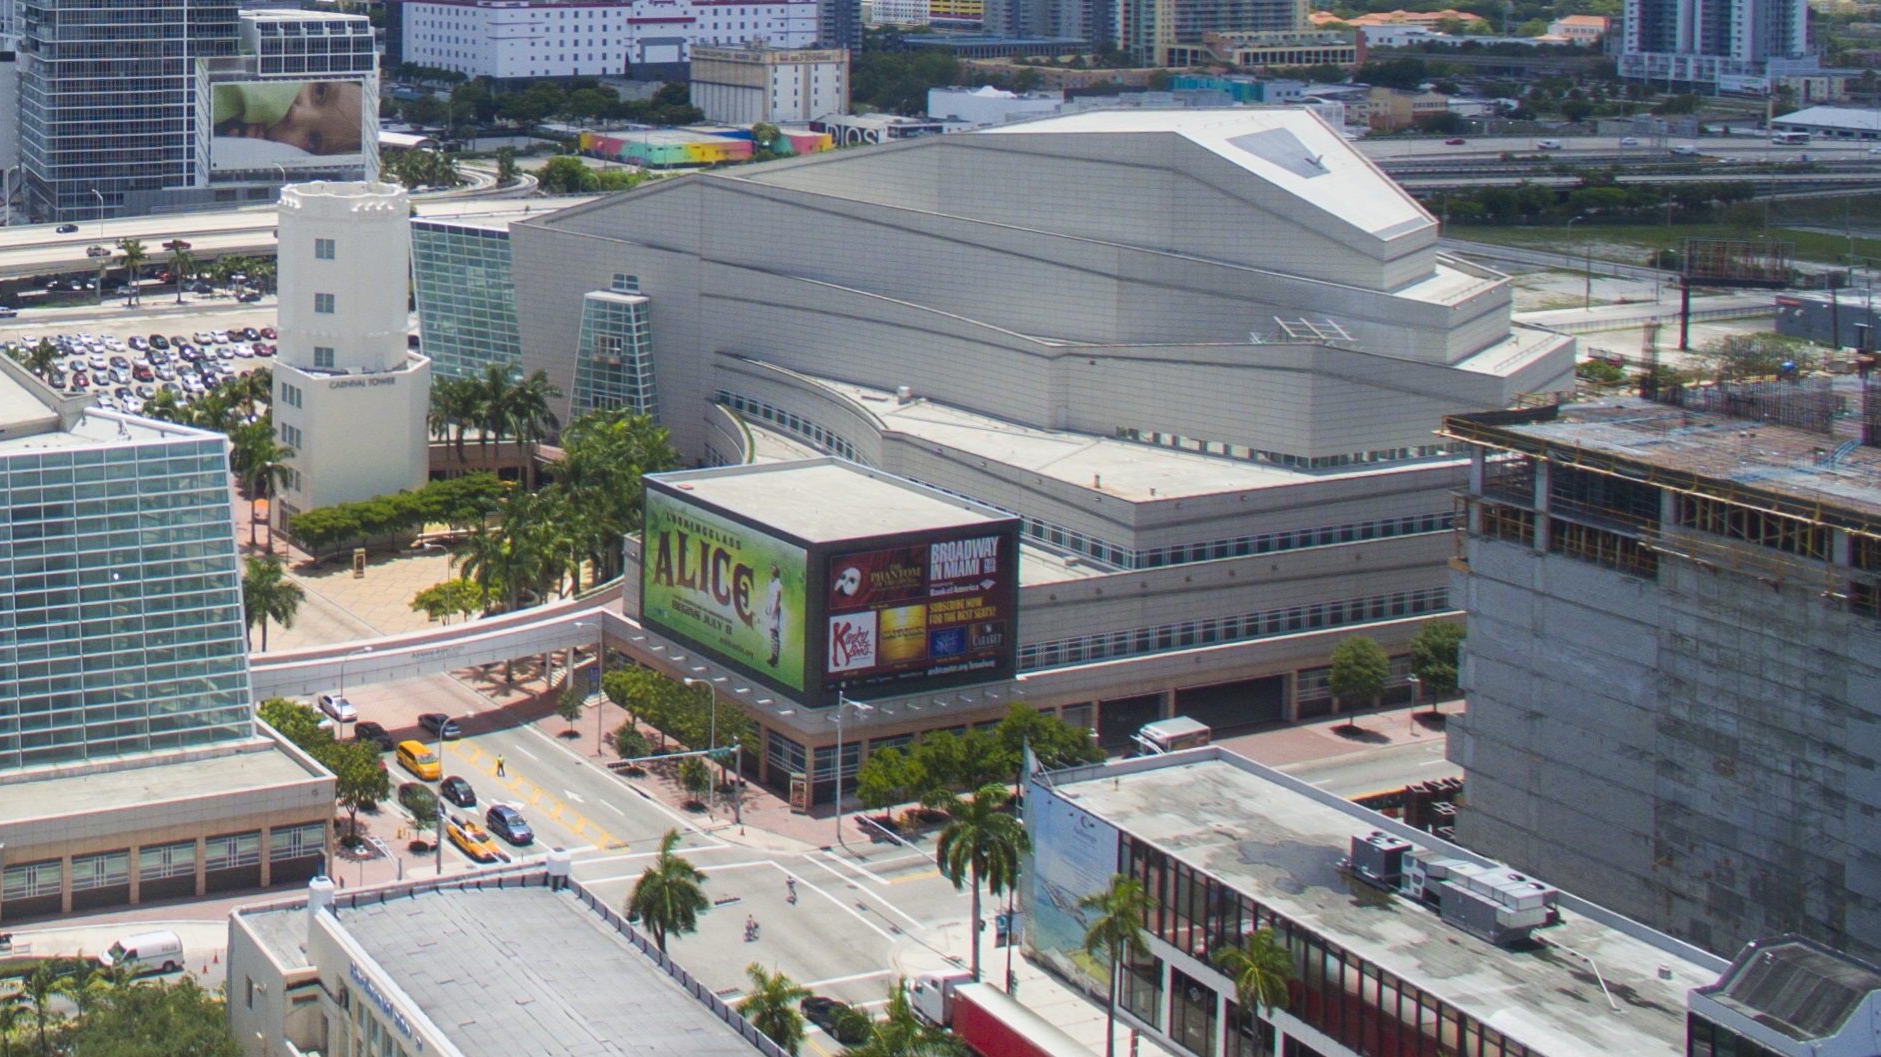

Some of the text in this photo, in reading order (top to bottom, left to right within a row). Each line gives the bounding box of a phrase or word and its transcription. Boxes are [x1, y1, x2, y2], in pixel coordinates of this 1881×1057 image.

[329, 376, 396, 390] CARNIVAL TOWER
[930, 535, 1000, 564] BROADWAY
[653, 529, 755, 630] ALICE
[870, 567, 921, 583] PHANTOM
[930, 562, 943, 581] IN
[943, 557, 980, 580] MIAMI
[929, 595, 984, 613] SUBSCRIBE NOW
[703, 614, 723, 631] JULY
[725, 624, 732, 635] 8
[929, 613, 943, 625] FOR
[943, 611, 957, 623] THE
[957, 609, 973, 621] BEST
[831, 621, 870, 667] Kinky
